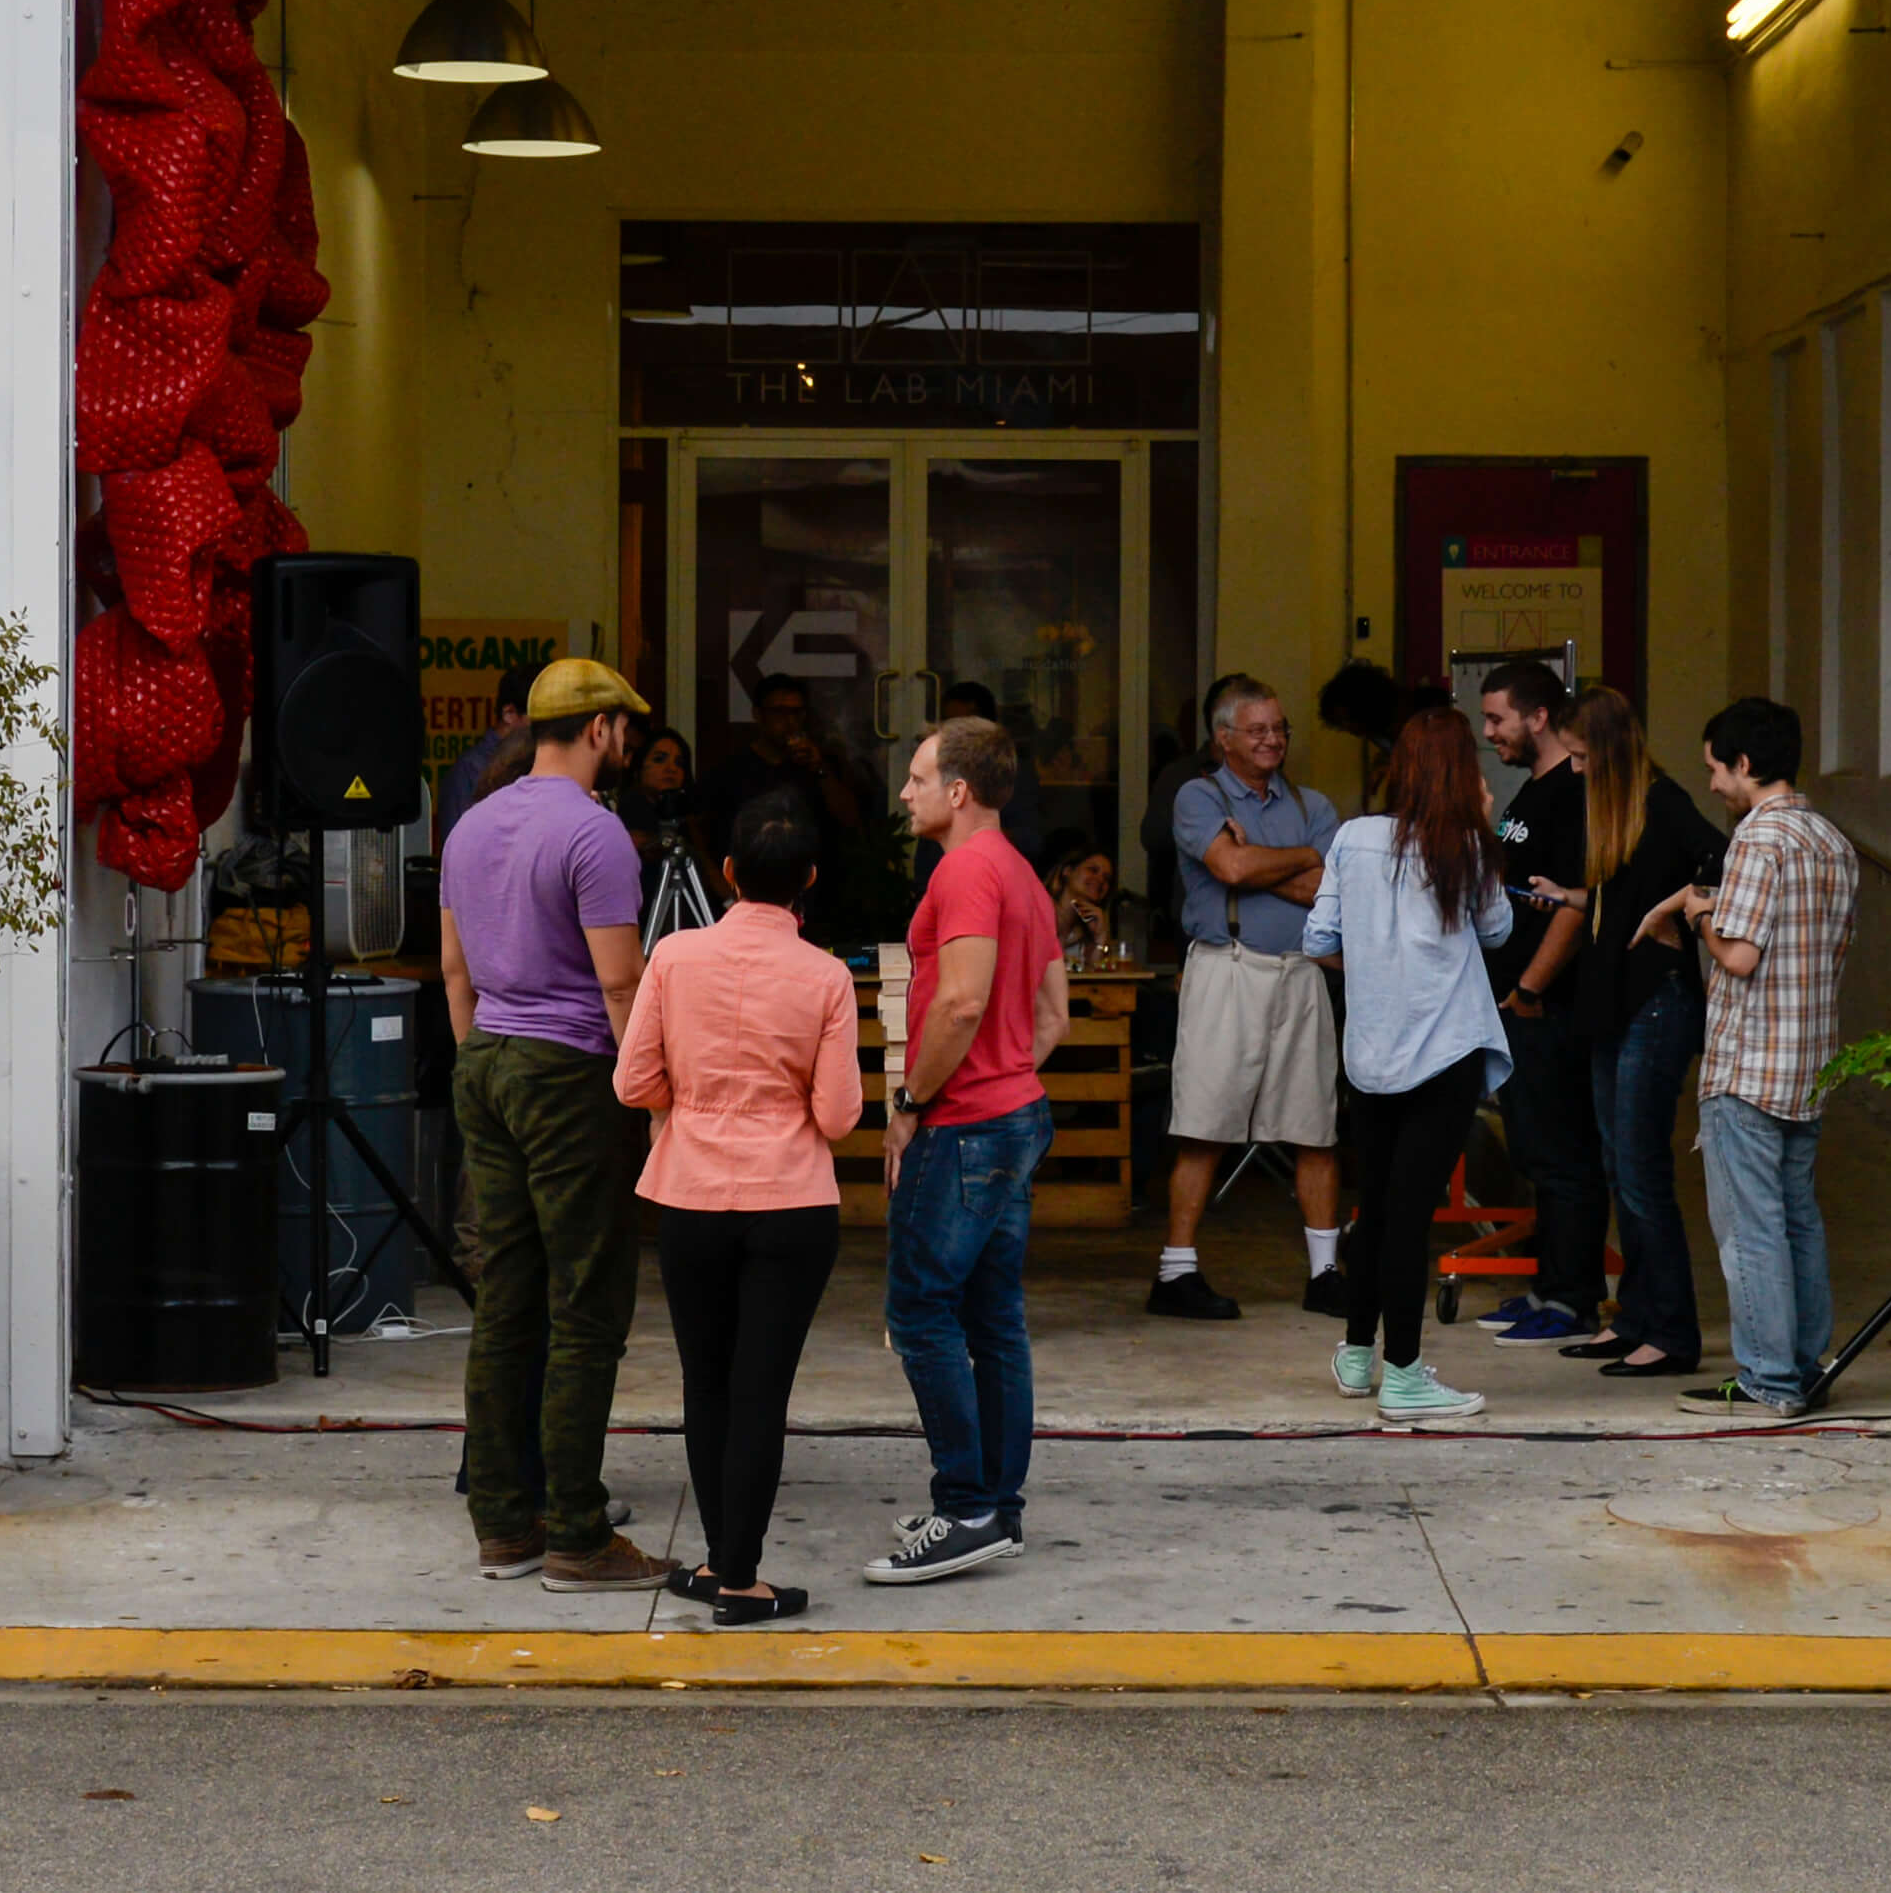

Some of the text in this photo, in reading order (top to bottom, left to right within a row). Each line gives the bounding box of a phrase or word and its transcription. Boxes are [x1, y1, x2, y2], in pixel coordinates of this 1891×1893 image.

[726, 372, 1093, 404] THE LAB MIAMI
[1473, 544, 1572, 560] ENTRANCE
[1461, 582, 1583, 600] WELCOME TO
